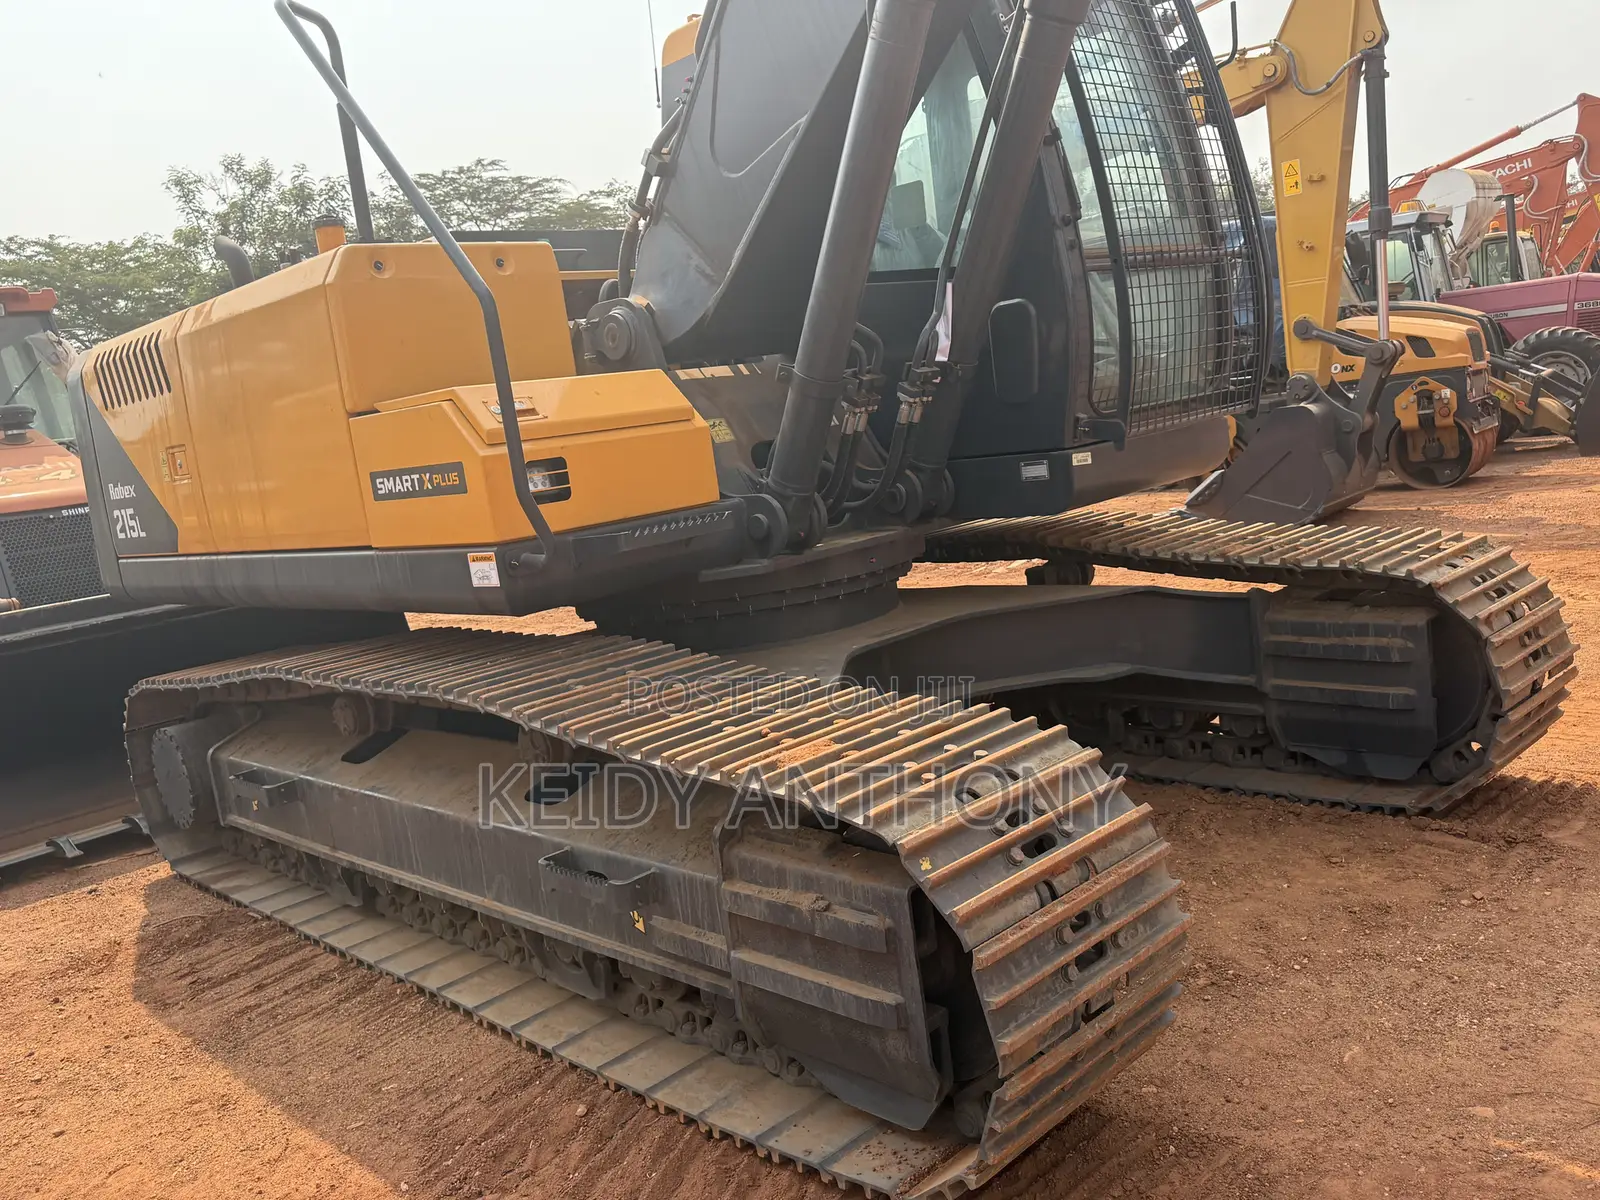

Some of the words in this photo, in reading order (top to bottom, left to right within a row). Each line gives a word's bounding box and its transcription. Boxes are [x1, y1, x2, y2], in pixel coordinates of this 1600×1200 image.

[1577, 301, 1600, 309] 368
[108, 482, 136, 500] Robex
[376, 474, 420, 495] SMART
[421, 473, 432, 490] X
[432, 472, 459, 486] PLUS
[113, 508, 146, 538] 215L
